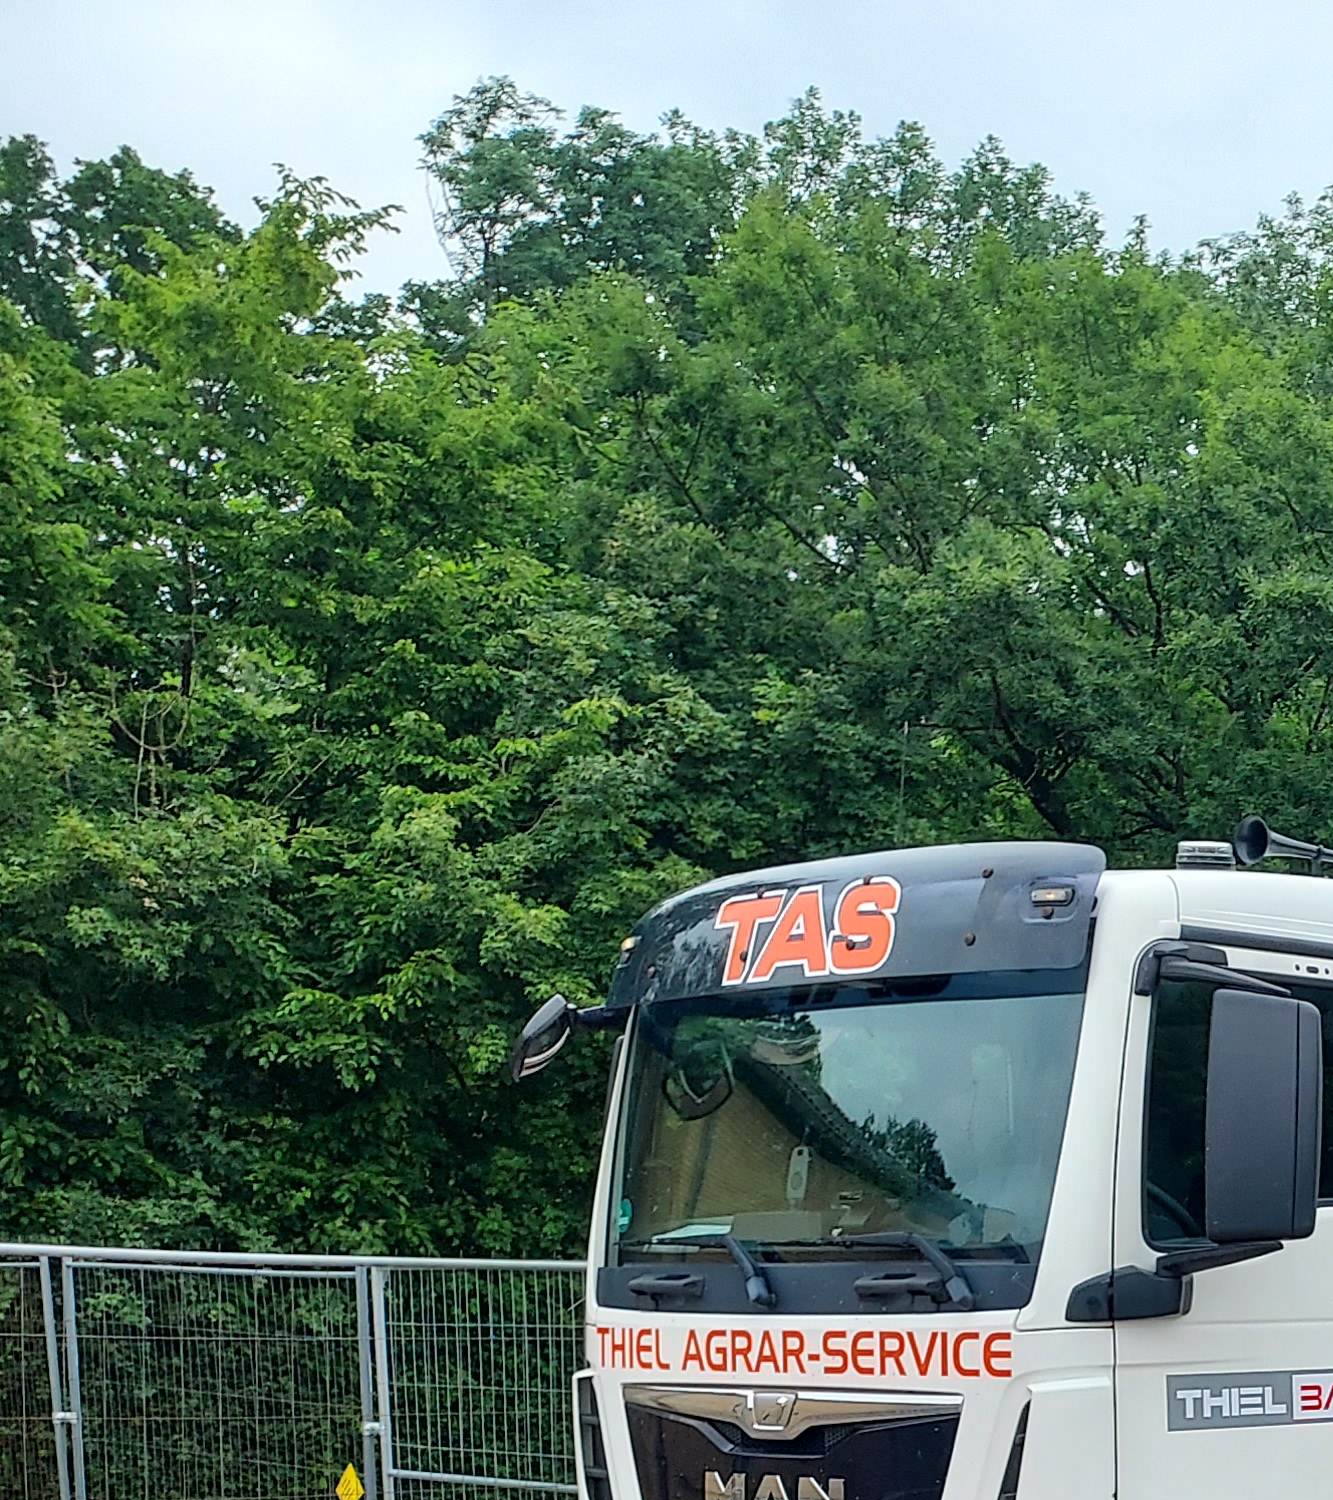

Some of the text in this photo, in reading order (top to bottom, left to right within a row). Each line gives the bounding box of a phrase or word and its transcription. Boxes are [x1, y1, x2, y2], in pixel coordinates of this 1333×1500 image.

[714, 875, 901, 986] TAS
[597, 1327, 1012, 1377] THIEL AGRAR-SERVICE
[1176, 1386, 1287, 1419] THIEL
